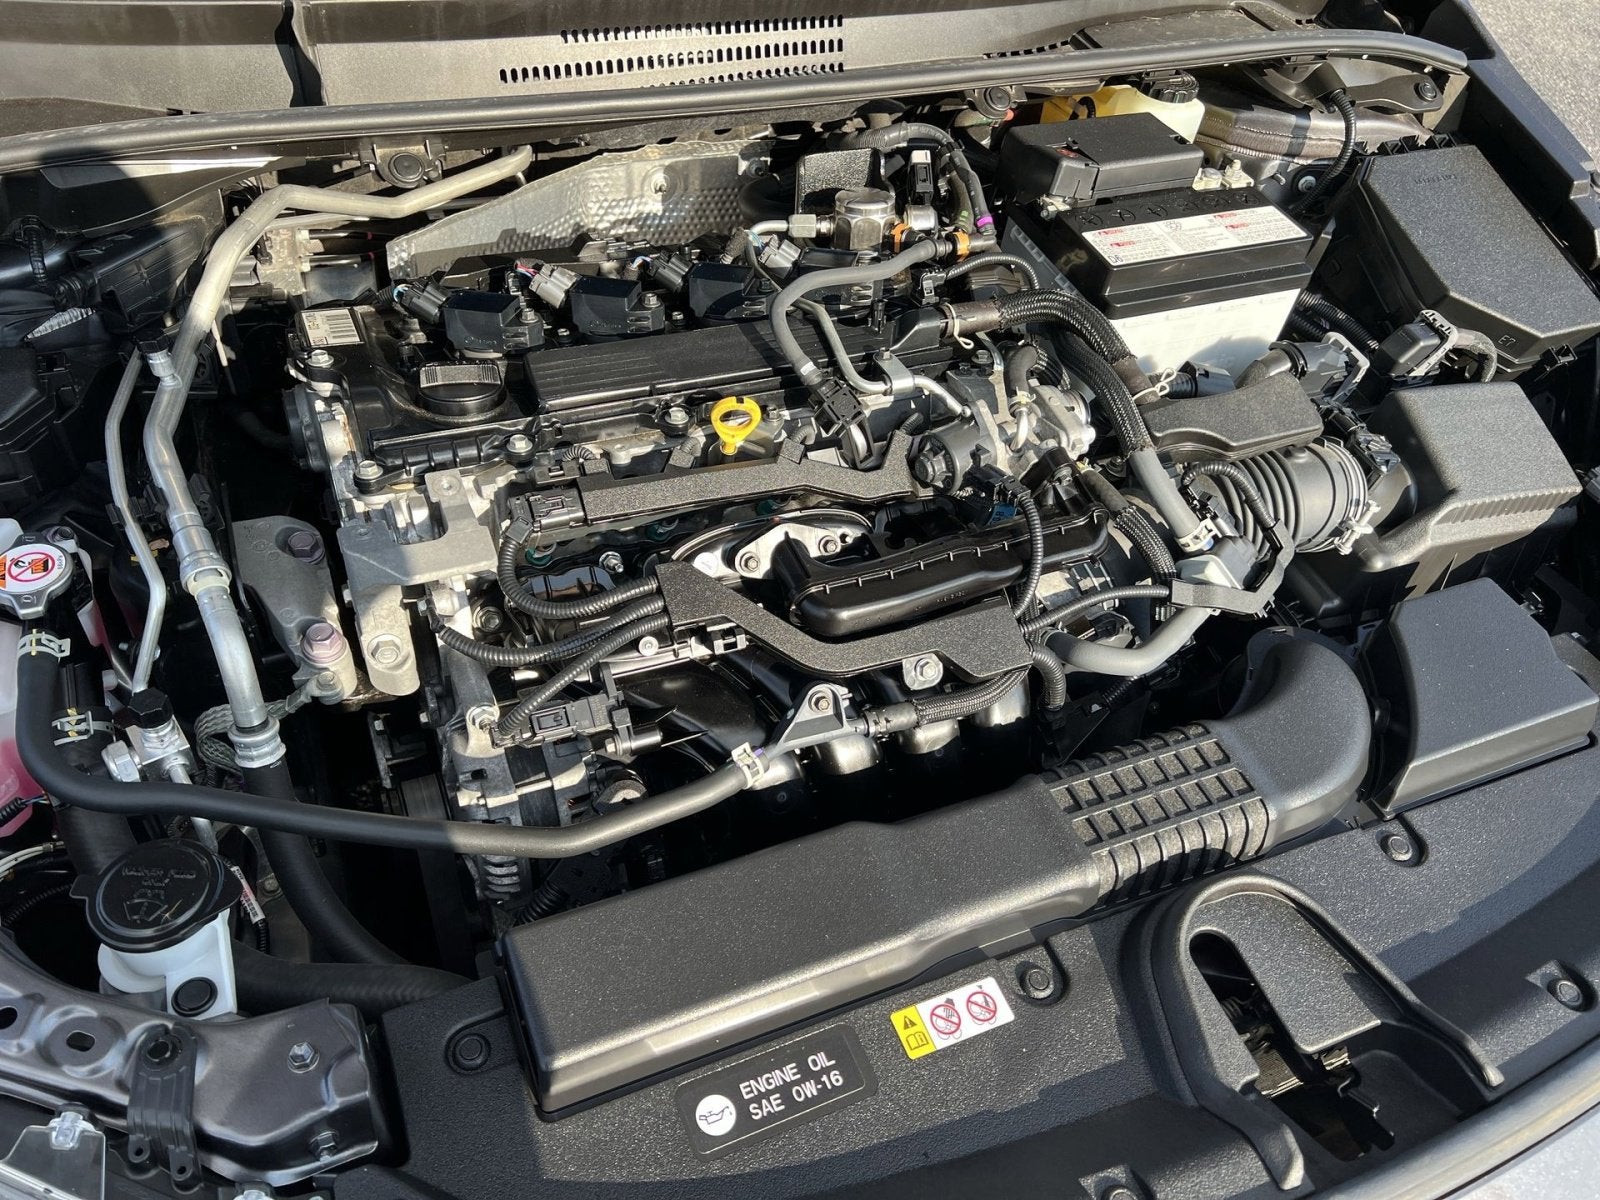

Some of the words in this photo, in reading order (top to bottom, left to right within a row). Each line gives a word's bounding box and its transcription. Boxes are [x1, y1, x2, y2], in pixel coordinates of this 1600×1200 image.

[739, 1063, 802, 1100] ENGINE
[807, 1051, 837, 1072] OIL
[749, 1093, 786, 1120] SAE
